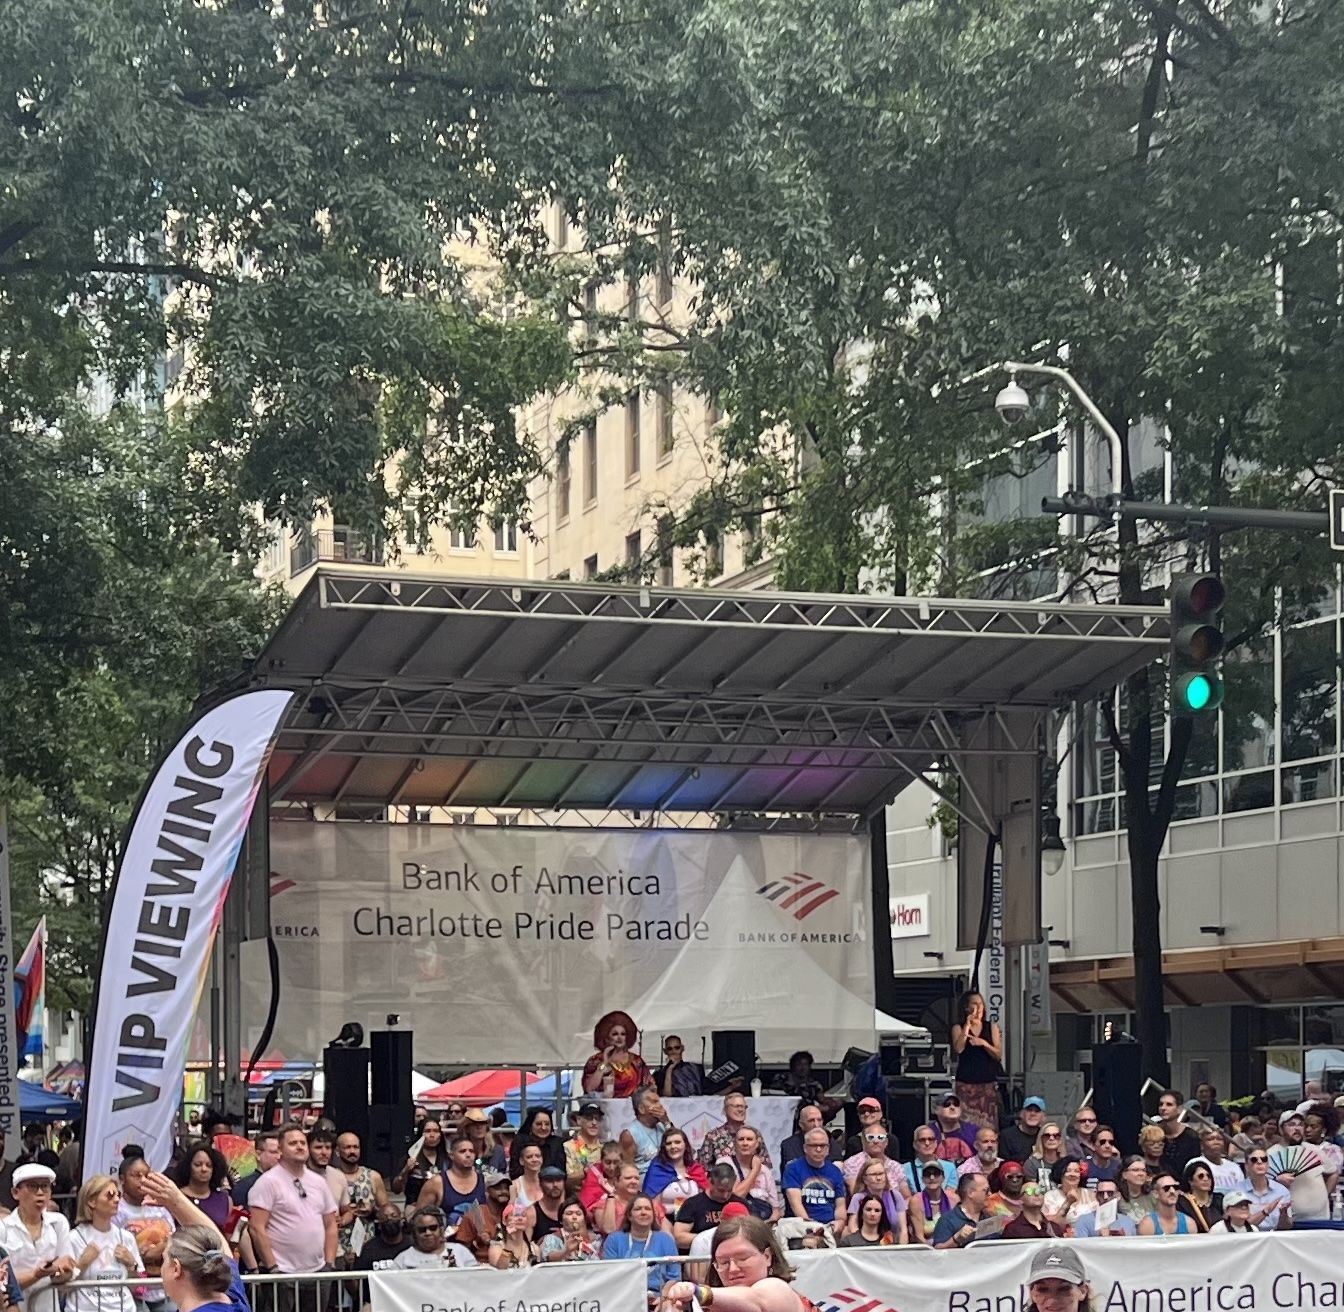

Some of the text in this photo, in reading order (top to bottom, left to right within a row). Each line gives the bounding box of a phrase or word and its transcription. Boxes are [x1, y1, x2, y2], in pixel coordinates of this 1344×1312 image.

[402, 862, 661, 897] Bank of America
[112, 734, 234, 1113] VIP VIEWING
[271, 925, 320, 938] ERICA
[353, 906, 711, 942] Charlotte Pride Parade
[738, 933, 863, 944] BANK OF AMERICA
